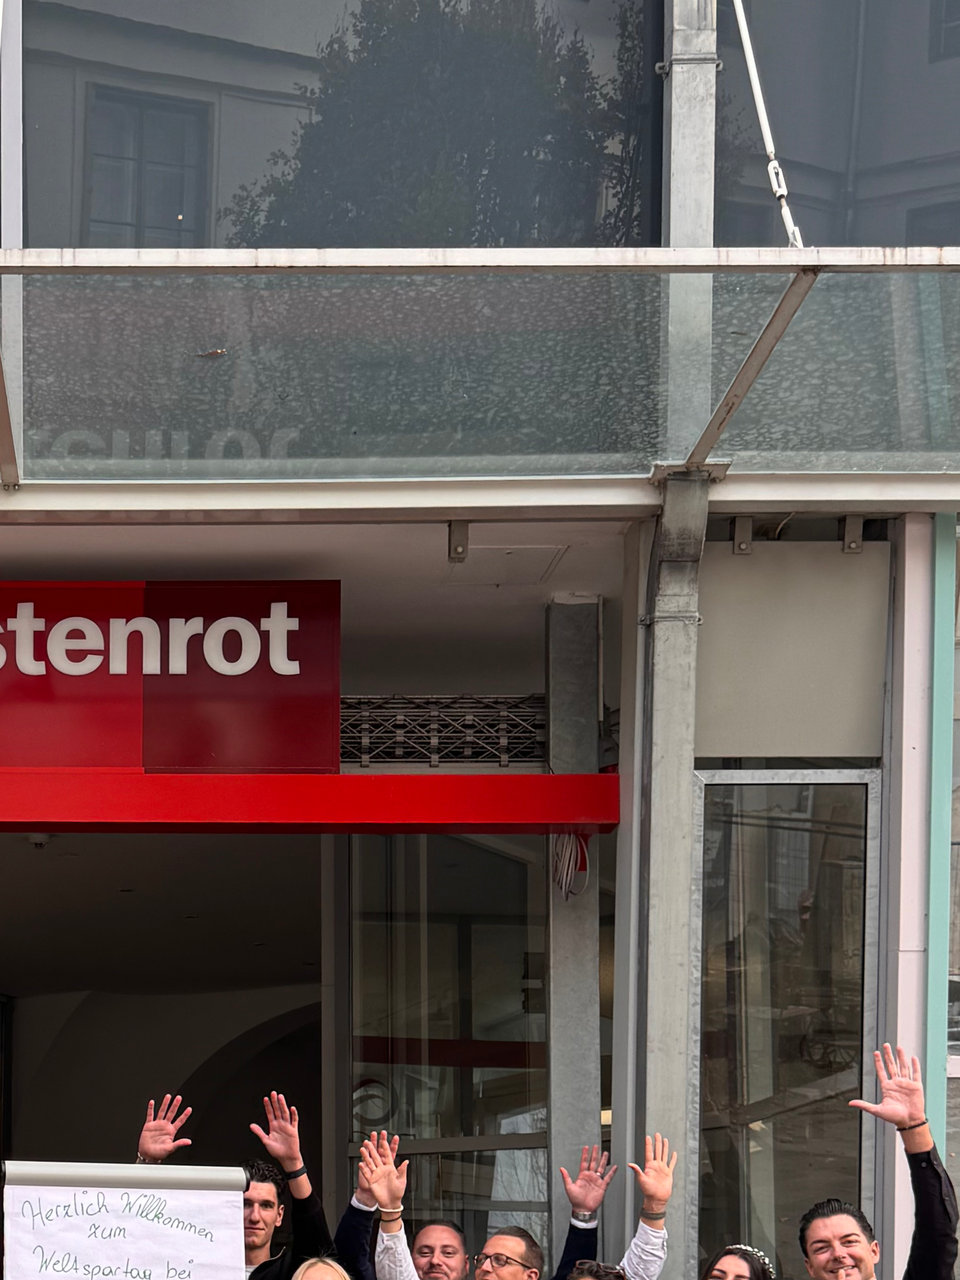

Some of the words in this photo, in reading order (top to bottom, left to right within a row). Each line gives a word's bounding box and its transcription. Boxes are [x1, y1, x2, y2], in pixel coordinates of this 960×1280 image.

[21, 1190, 109, 1230] Herzlich
[120, 1192, 214, 1242] Willkommen
[87, 1223, 127, 1240] zum
[166, 1259, 194, 1280] bei
